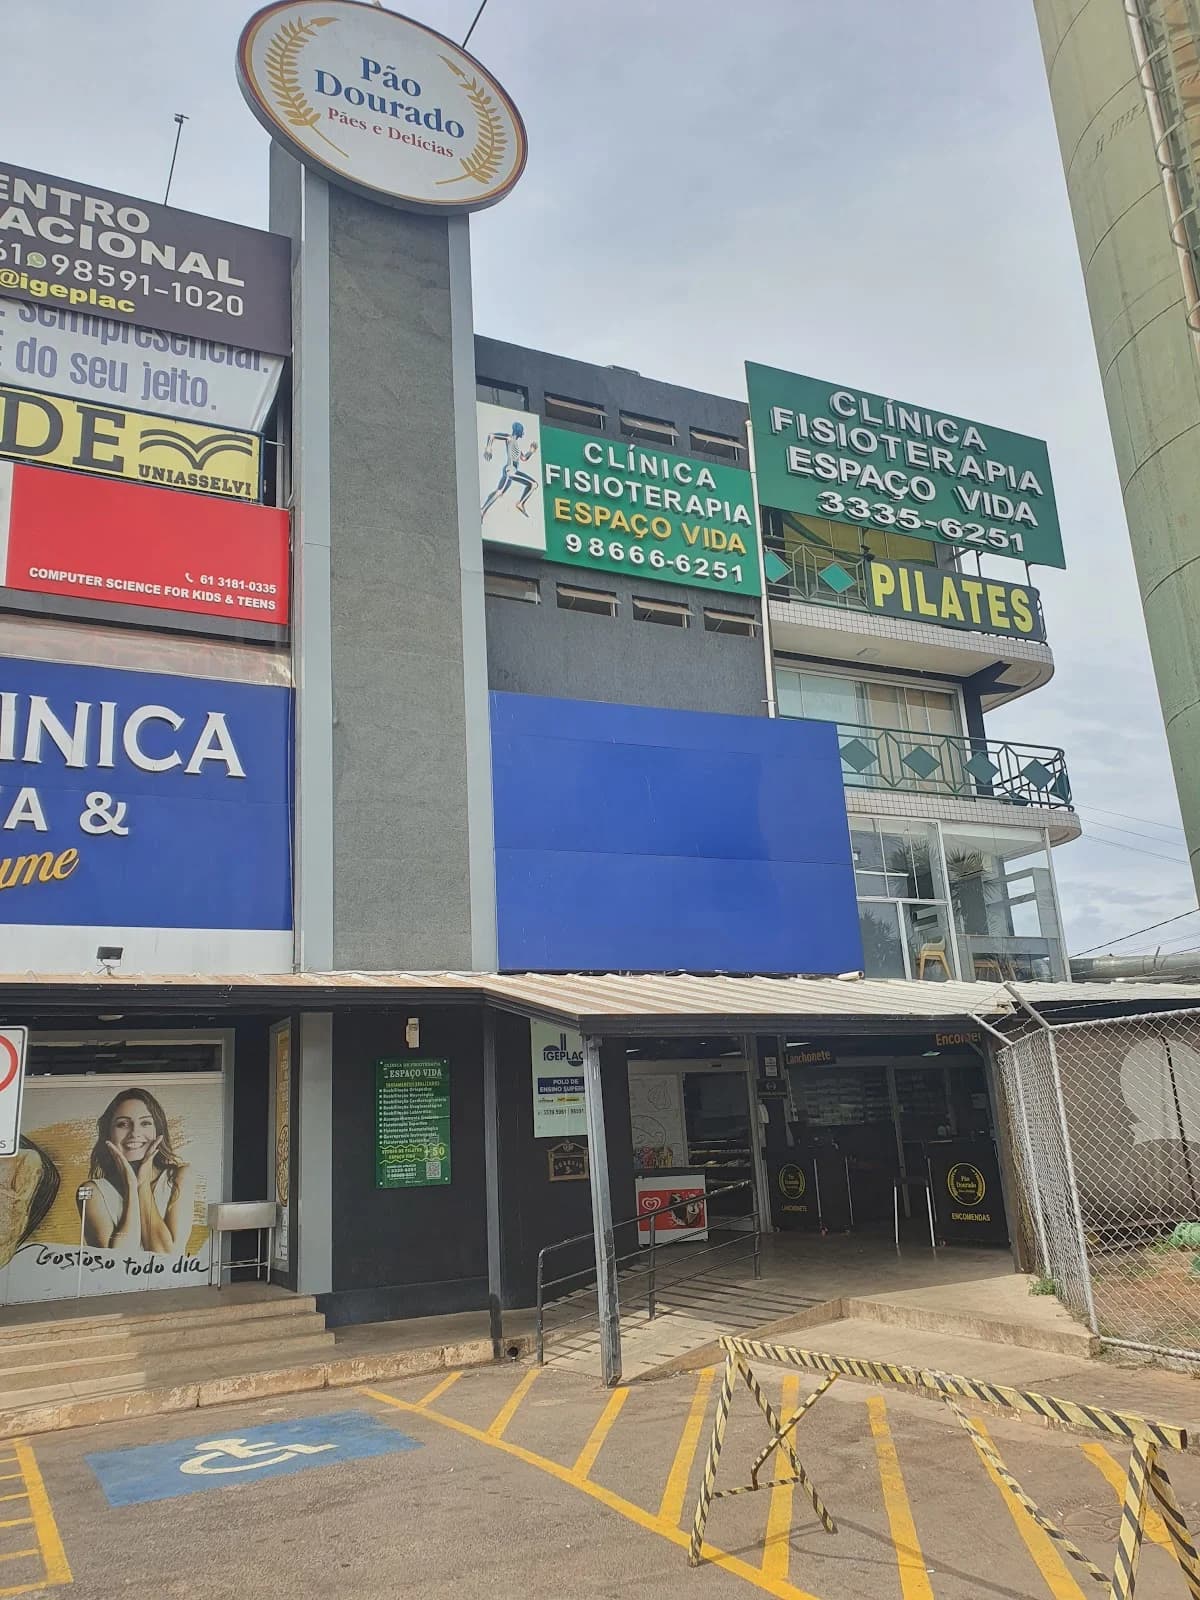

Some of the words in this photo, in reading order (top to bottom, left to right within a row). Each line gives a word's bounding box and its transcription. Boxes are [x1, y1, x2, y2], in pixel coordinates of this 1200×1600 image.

[314, 69, 464, 138] Dourado
[360, 56, 421, 97] Pão
[327, 106, 367, 131] Pães
[373, 125, 382, 135] e
[388, 125, 454, 158] Delícias
[0, 206, 245, 287] ACIONAL
[0, 268, 136, 313] @igeplac
[51, 253, 244, 317] 98591-1020
[16, 337, 58, 378] do
[70, 353, 128, 393] seu
[141, 361, 216, 410] jeito.
[0, 389, 126, 473] DE
[830, 391, 987, 451] CLÍNICA
[584, 442, 717, 489] CLÍNICA
[770, 405, 1043, 496] FISIOTERAPIA
[138, 464, 251, 496] UNIASSELVI
[545, 463, 752, 526] FISIOTERAPIA
[787, 445, 936, 502] ESPAÇO
[954, 485, 1039, 527] VIDA
[554, 498, 672, 539] ESPAÇO
[681, 522, 747, 555] VIDA
[817, 491, 1025, 553] 3335-6251
[200, 575, 213, 585] 61
[218, 576, 277, 594] 3181-0335
[565, 533, 743, 583] 98666-6251
[29, 567, 103, 587] COMPUTER
[106, 578, 161, 595] SCIENCE
[164, 586, 189, 599] FOR
[192, 590, 221, 603] KIDS
[225, 594, 233, 604] &
[237, 595, 276, 610] TEENS
[870, 560, 1034, 633] PILATES
[0, 692, 246, 778] INICA
[0, 786, 48, 831] A
[79, 791, 129, 836] &
[390, 1069, 421, 1079] ESPAÇO
[423, 1067, 442, 1077] VIDA
[35, 1244, 115, 1272] Gostoso
[123, 1257, 165, 1276] todo
